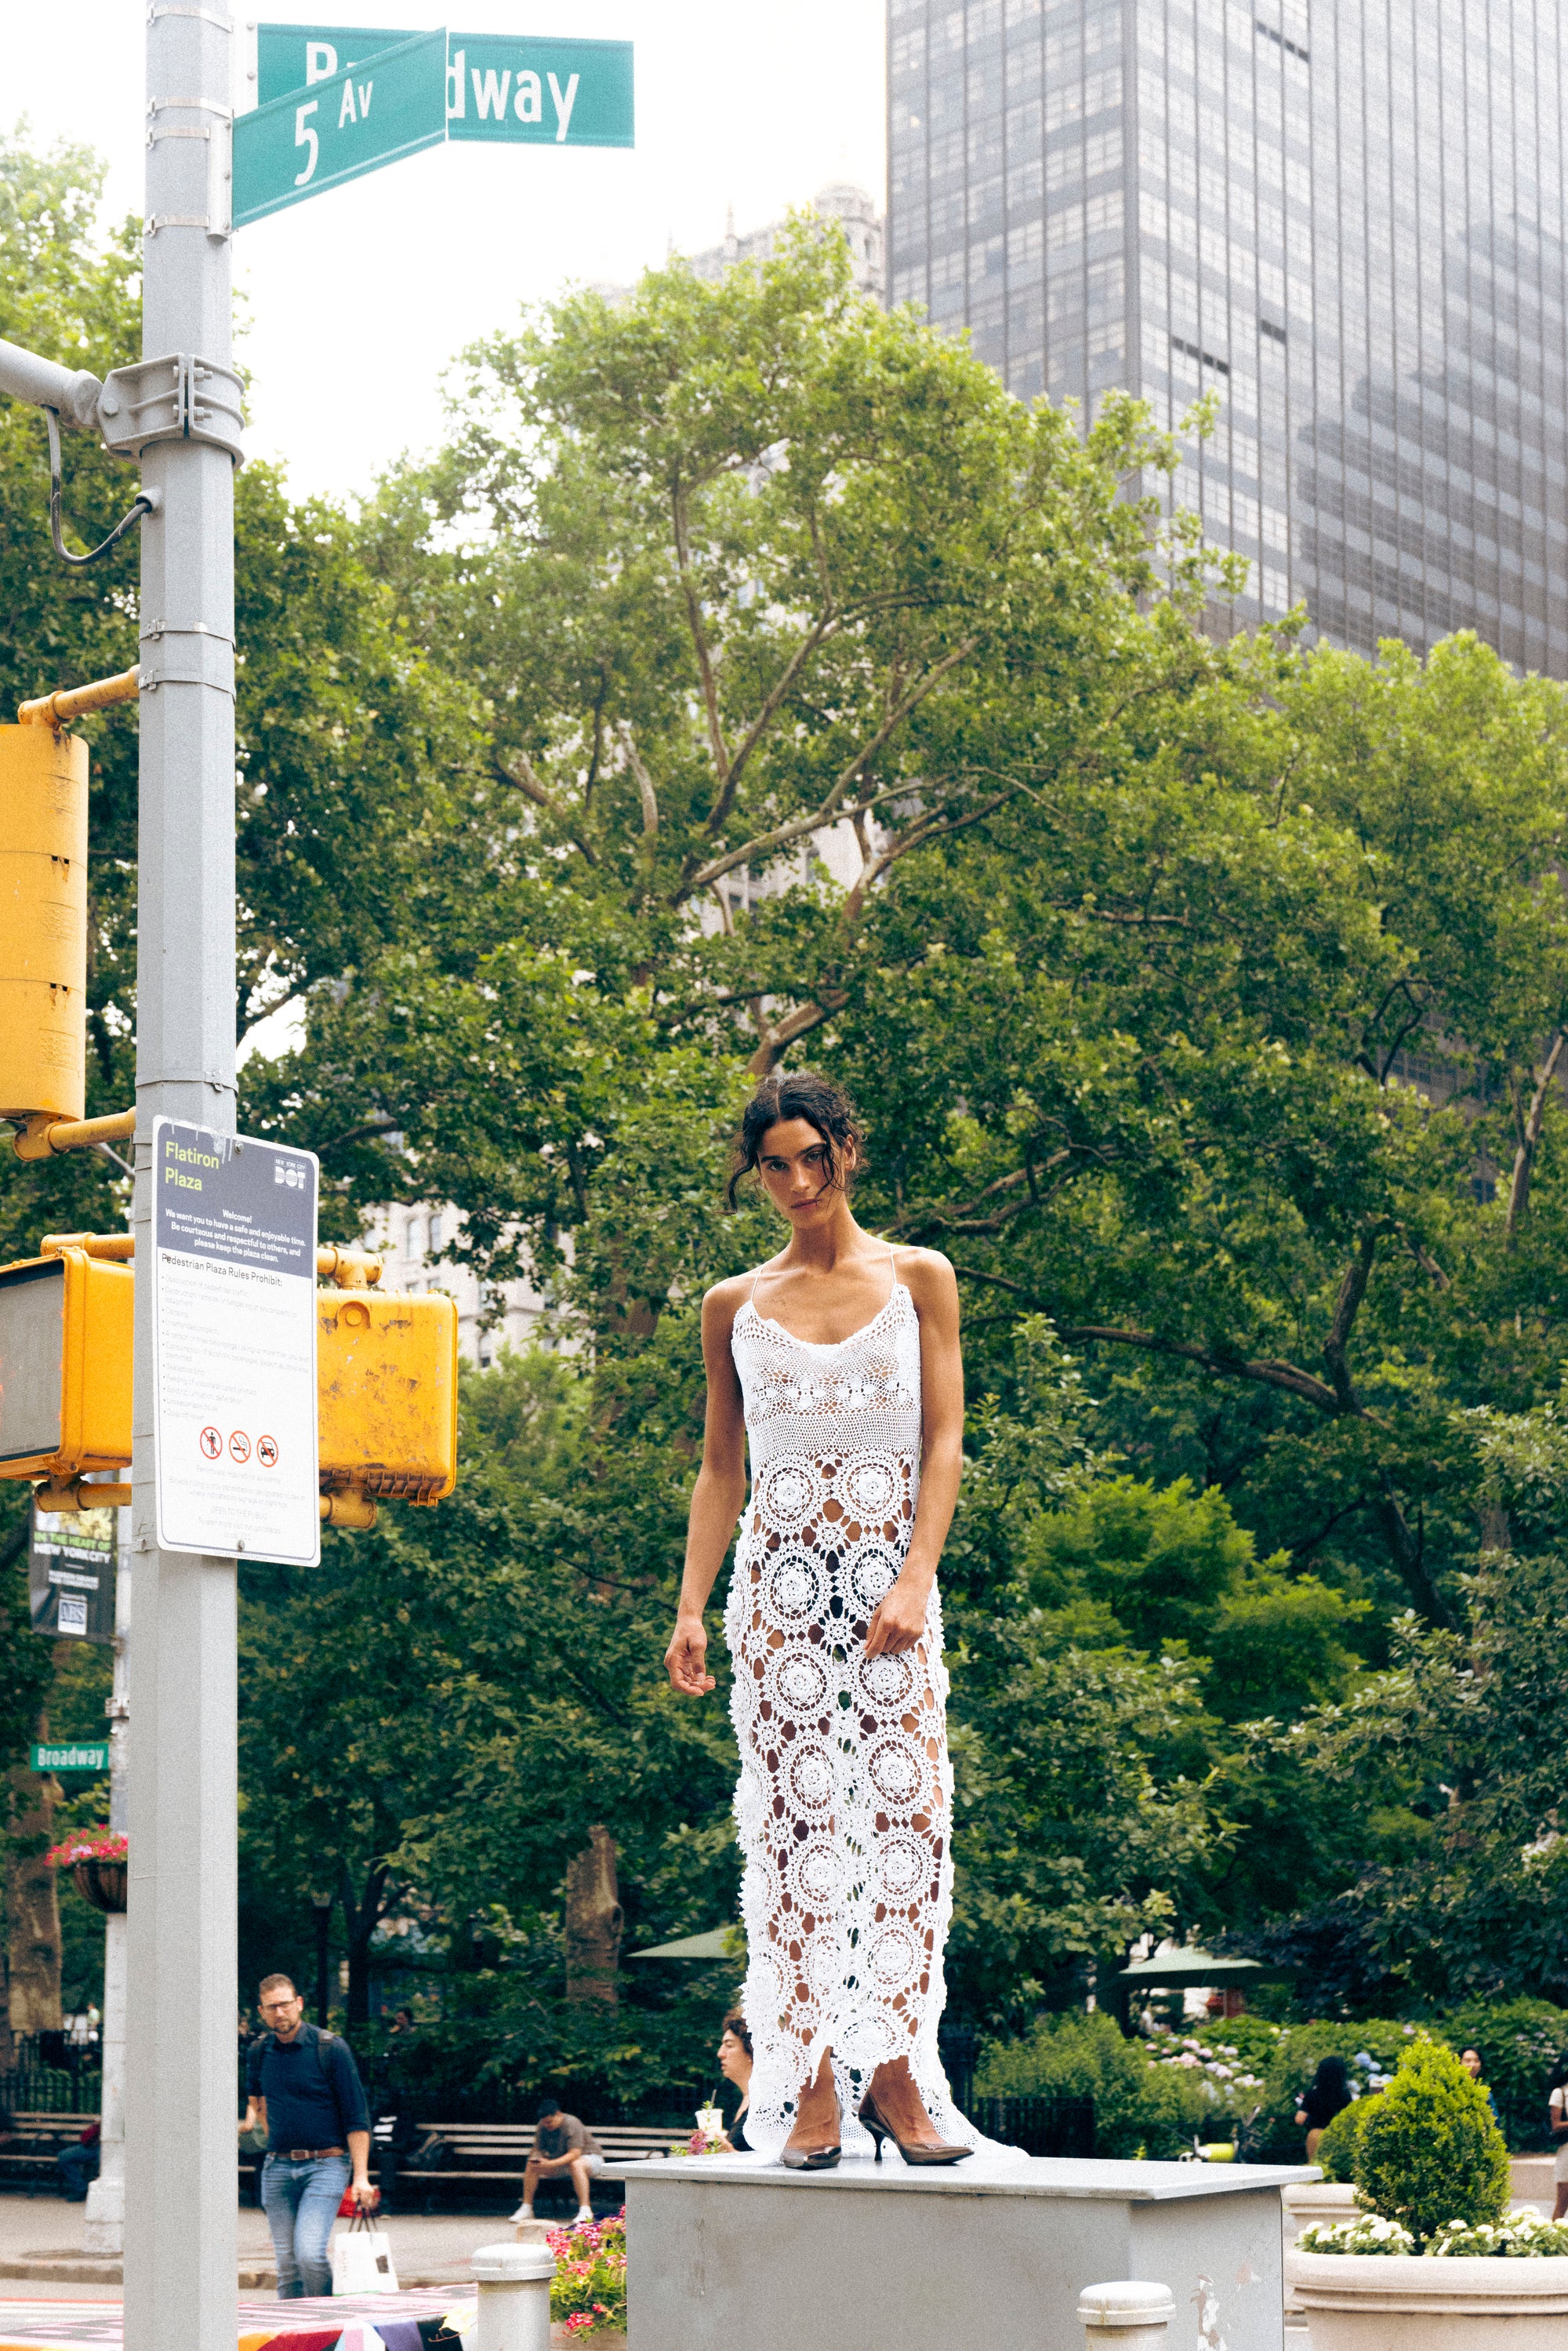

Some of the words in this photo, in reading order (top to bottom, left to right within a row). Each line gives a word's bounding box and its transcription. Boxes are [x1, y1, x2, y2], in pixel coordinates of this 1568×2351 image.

[294, 100, 319, 186] 5
[338, 78, 373, 129] Av
[165, 1140, 220, 1169] Flatiron
[165, 1166, 202, 1191] Plaza
[274, 1165, 306, 1189] DOT
[165, 1208, 176, 1218] We
[176, 1212, 193, 1222] want
[193, 1215, 205, 1224] you
[205, 1217, 213, 1226] to
[213, 1219, 229, 1230] have
[234, 1225, 249, 1234] safe
[249, 1228, 261, 1237] and
[261, 1230, 290, 1243] enjoyable
[291, 1236, 307, 1247] time.
[222, 1208, 252, 1223] Welcome!
[171, 1221, 180, 1231] Be
[180, 1225, 213, 1237] courteous
[213, 1232, 227, 1241] and
[227, 1234, 259, 1247] respectful
[267, 1244, 289, 1255] others,
[289, 1248, 301, 1257] and
[194, 1237, 216, 1250] please
[216, 1241, 231, 1254] keep
[231, 1245, 243, 1255] the
[243, 1248, 260, 1258] plaza
[260, 1252, 279, 1263] clean.
[162, 1253, 204, 1270] Pedestrian
[206, 1262, 227, 1275] Plaza
[228, 1266, 250, 1280] Rules
[251, 1271, 283, 1286] Prohibit:
[34, 1543, 61, 1556] NEW
[62, 1546, 89, 1561] YORK
[89, 1550, 112, 1564] CITY
[37, 1745, 104, 1770] Broadway
